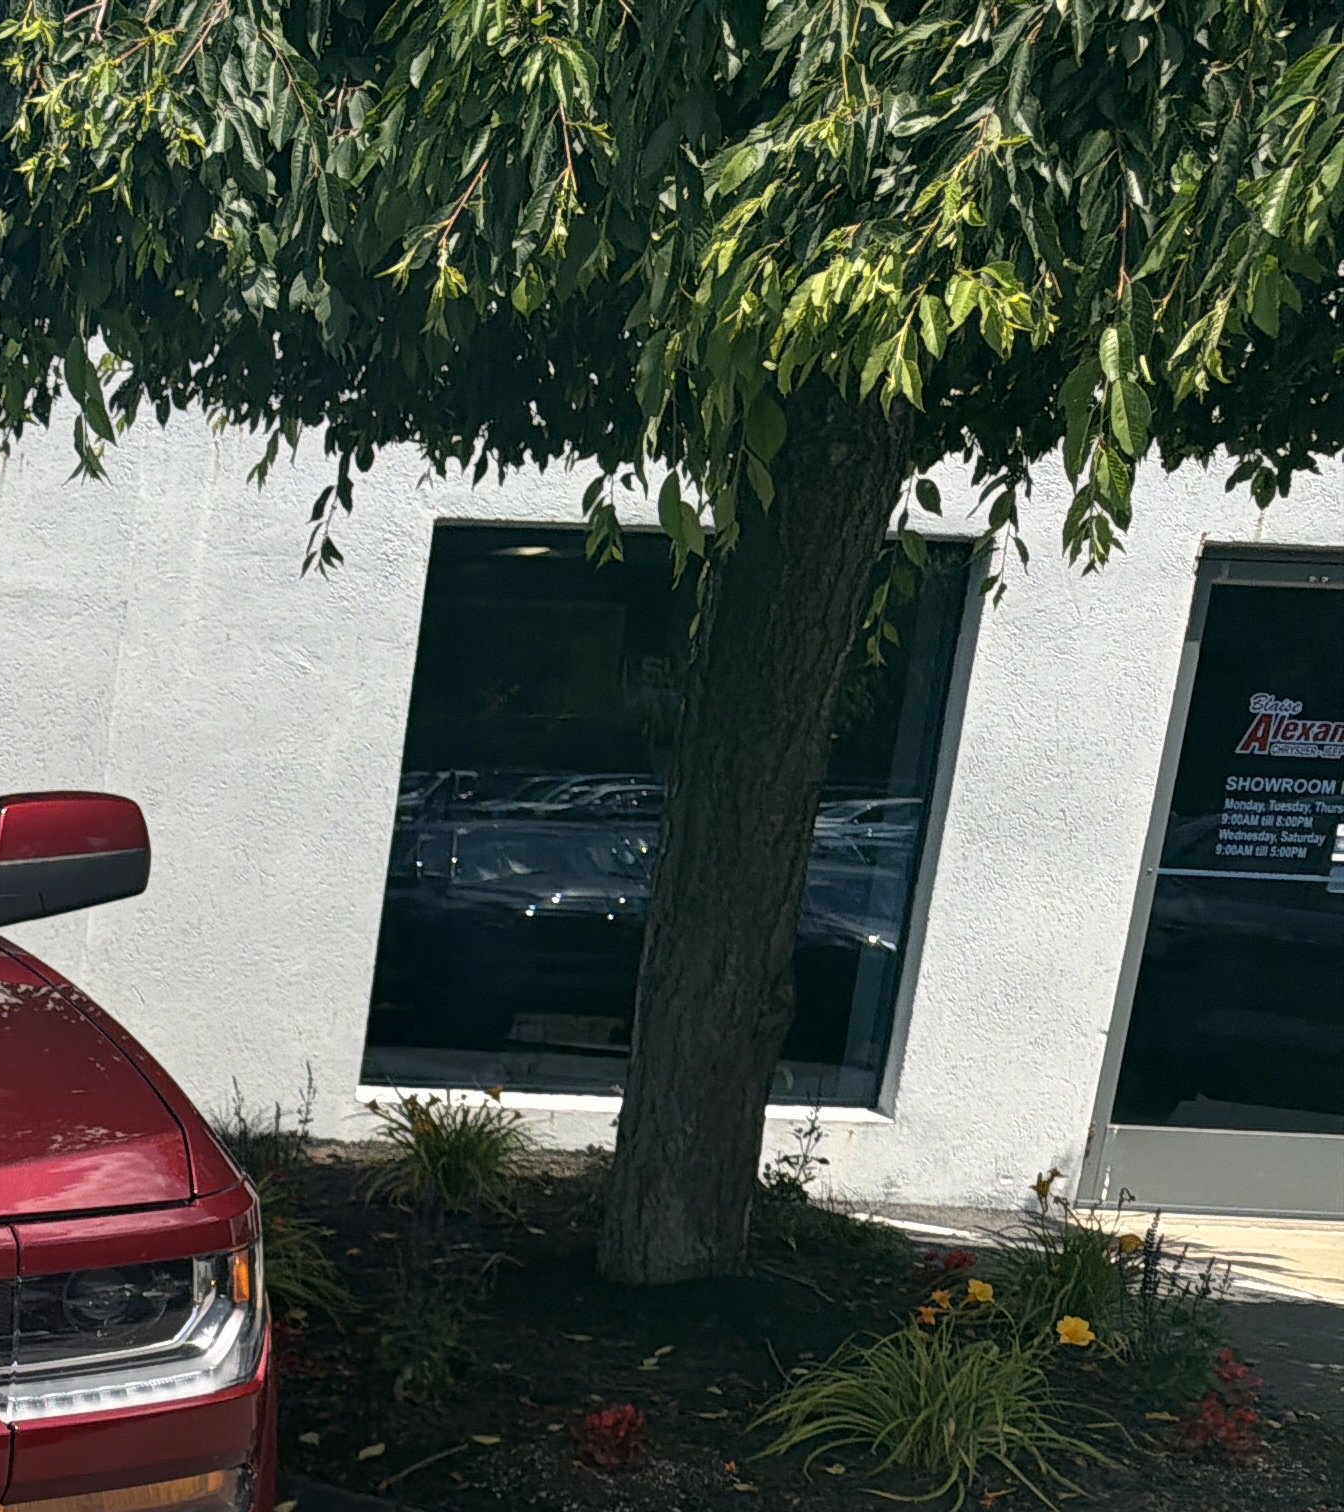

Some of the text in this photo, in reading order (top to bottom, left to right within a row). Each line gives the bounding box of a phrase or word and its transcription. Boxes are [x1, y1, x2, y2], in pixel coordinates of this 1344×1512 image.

[1249, 692, 1303, 715] Blaise
[1225, 776, 1336, 794] SHOWROOM
[1224, 798, 1266, 813] Monday,
[1269, 799, 1312, 814] Tuesday,
[1221, 813, 1260, 826] 9:00AM
[1261, 814, 1274, 827] till
[1219, 829, 1277, 844] Wednesday,
[1280, 831, 1327, 847] Saturday
[1215, 843, 1253, 856] 9:00AM
[1255, 844, 1268, 857] till
